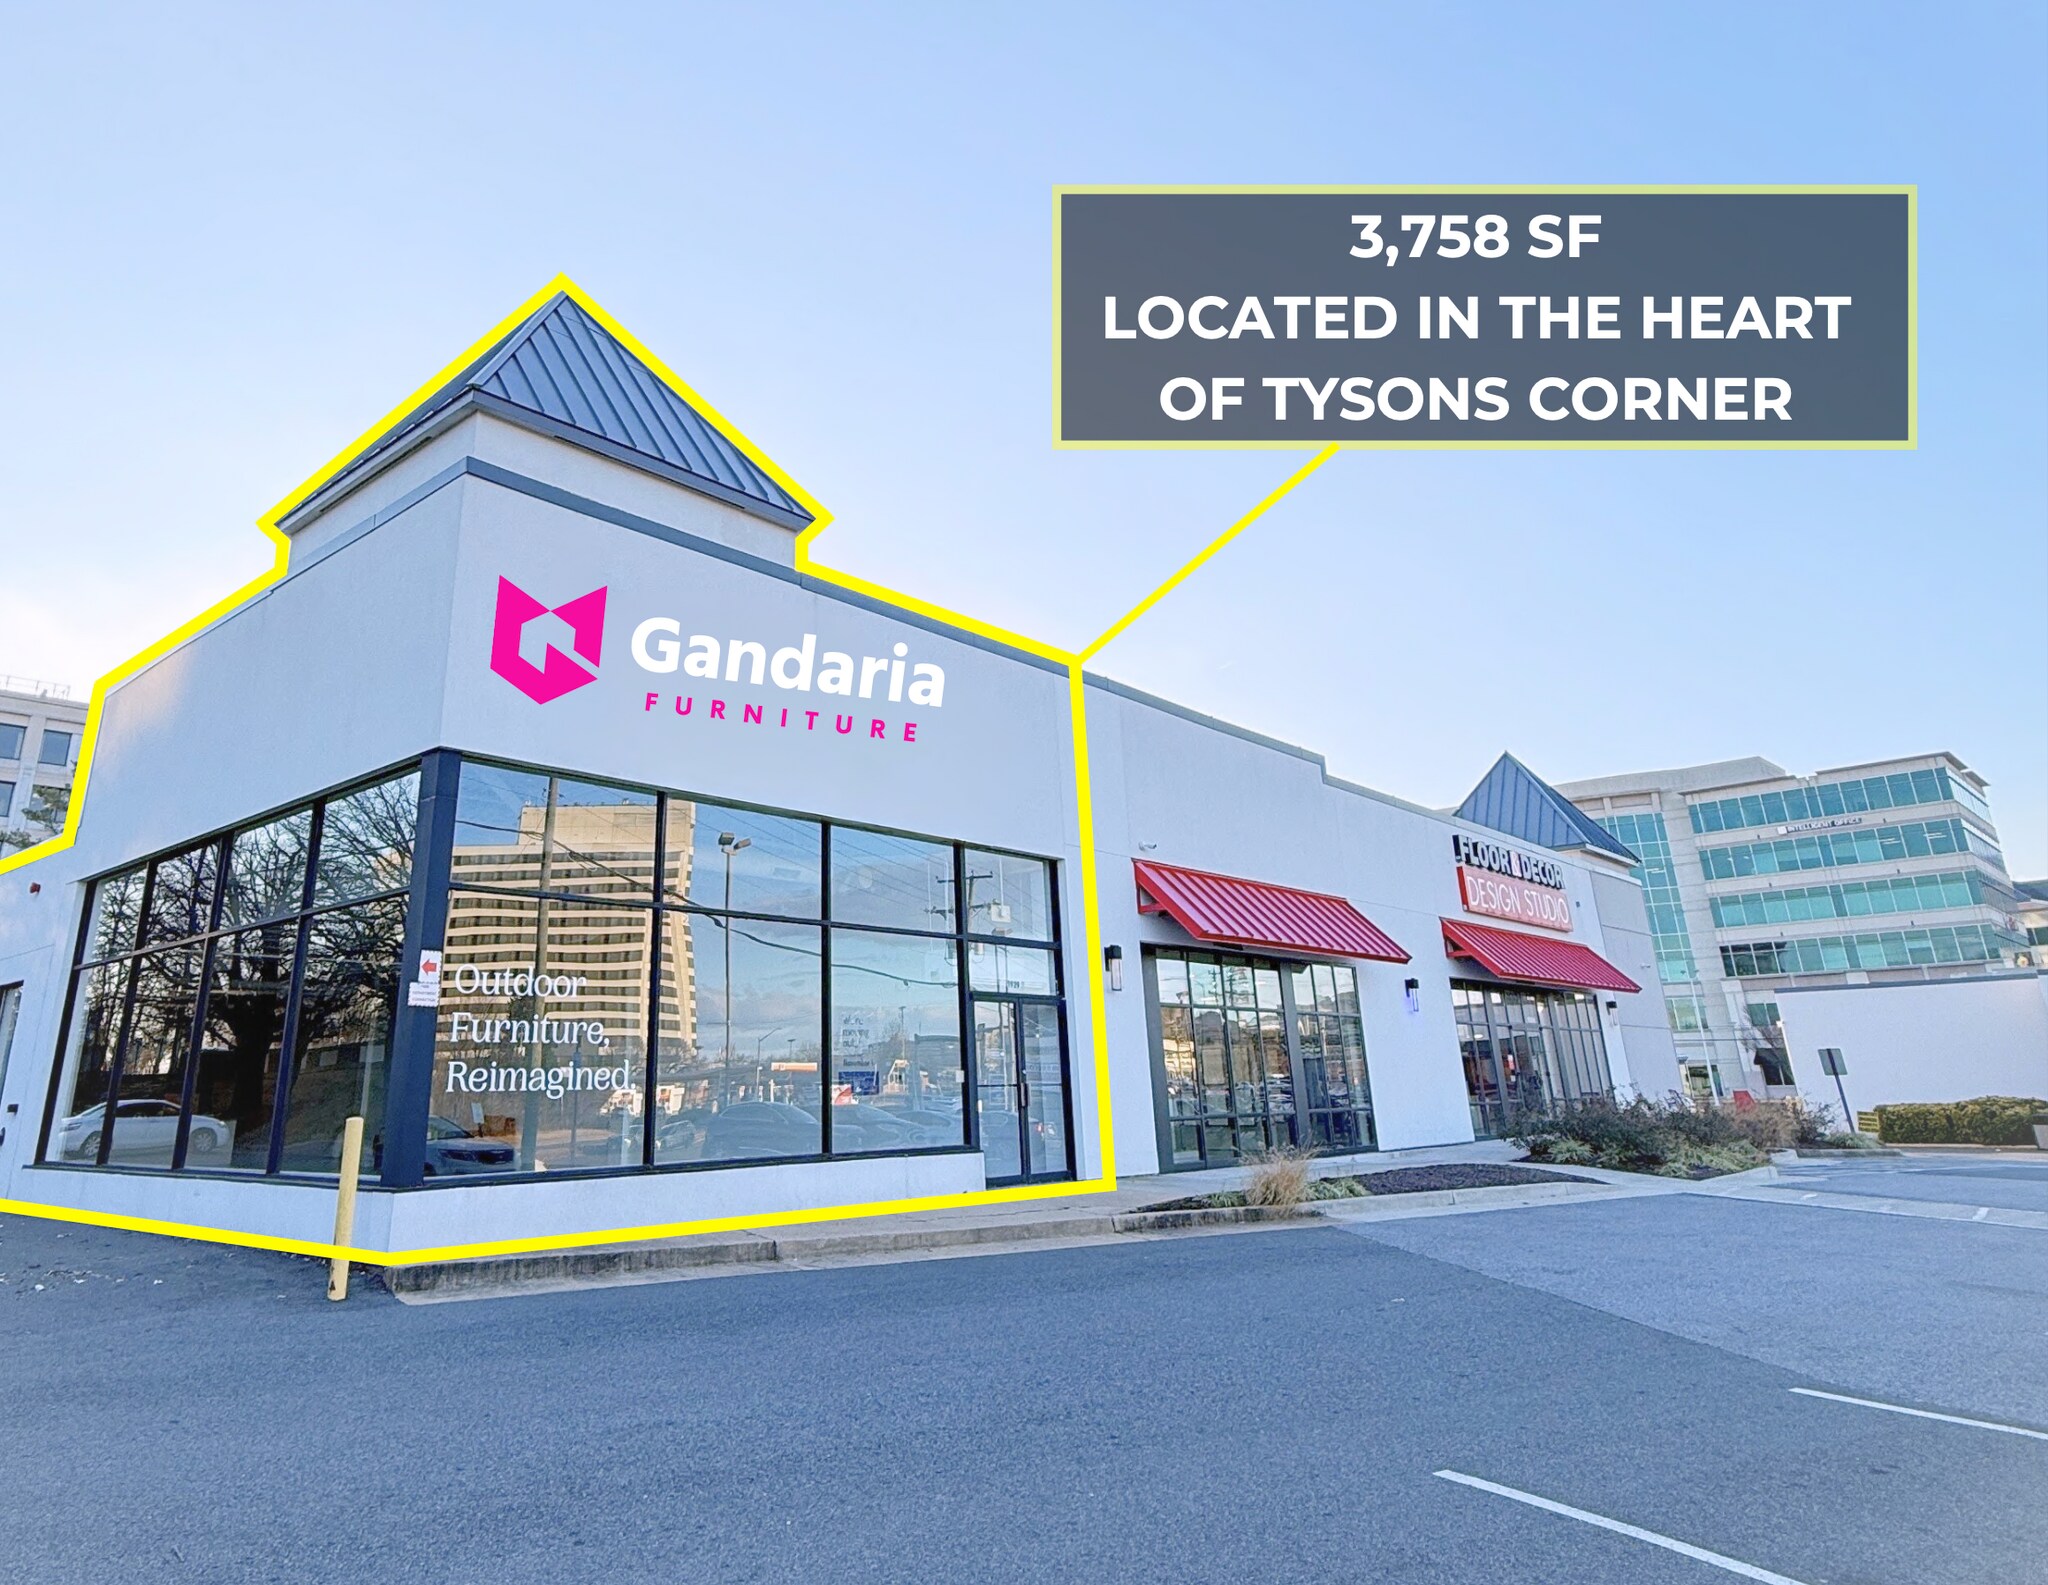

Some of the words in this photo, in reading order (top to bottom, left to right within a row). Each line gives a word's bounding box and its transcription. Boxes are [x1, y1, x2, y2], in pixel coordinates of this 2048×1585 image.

[631, 617, 945, 707] Gandaria
[645, 692, 917, 742] FURNITURE
[1466, 876, 1521, 914] DESIGN
[1524, 888, 1569, 924] STUDIO
[455, 963, 587, 998] Outdoor
[450, 1012, 610, 1048] Furniture,
[445, 1059, 637, 1100] Reimagined.
